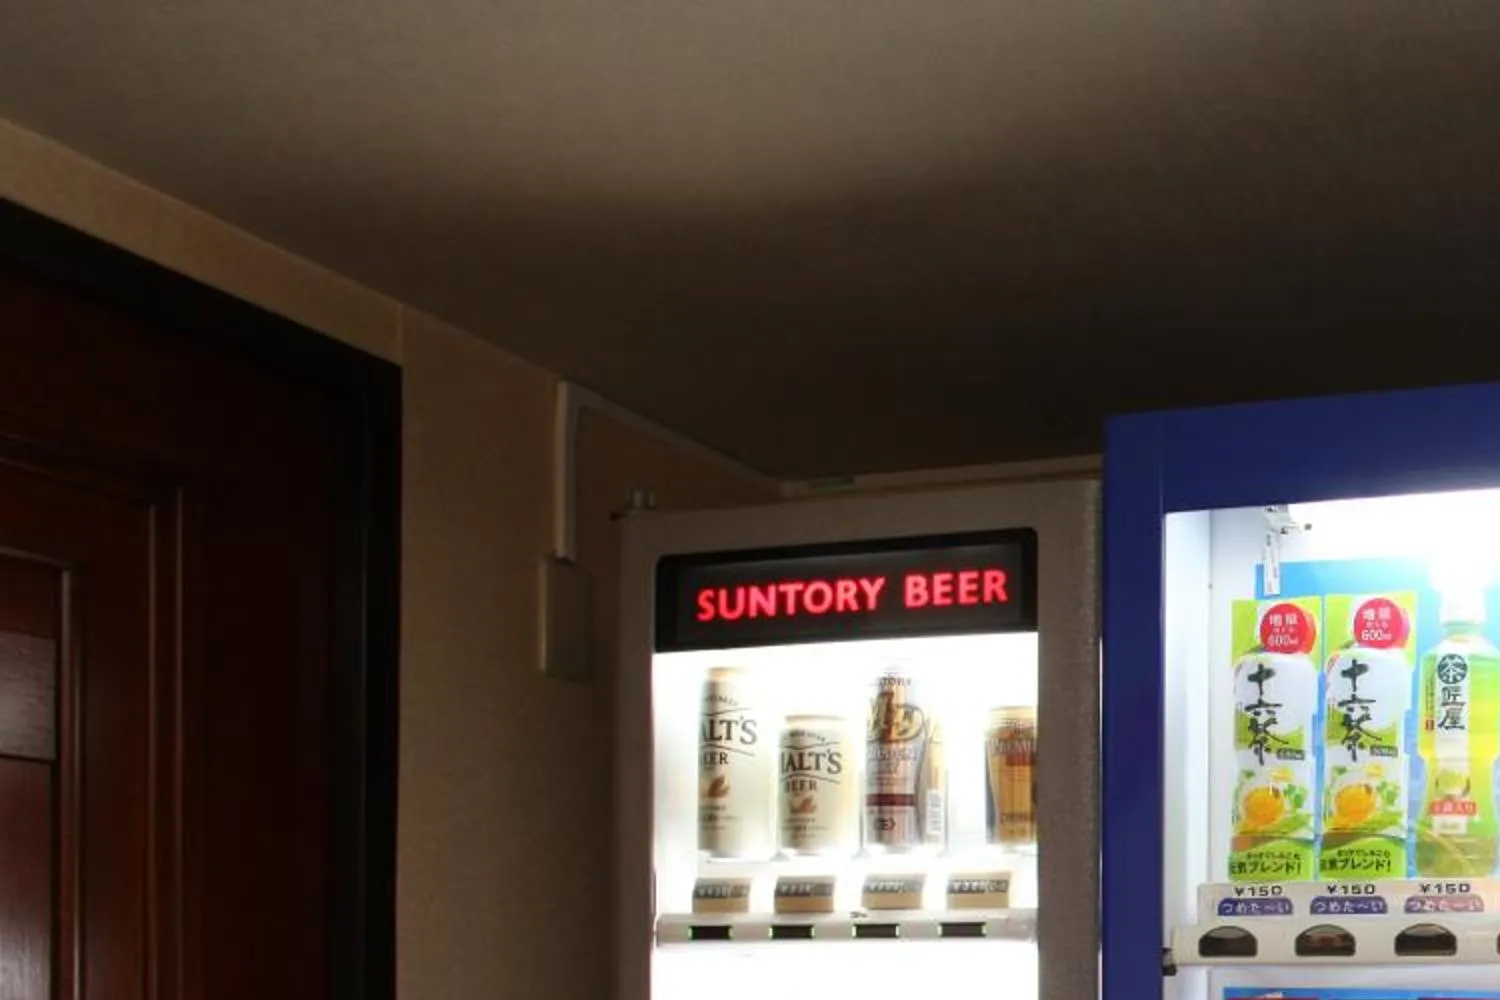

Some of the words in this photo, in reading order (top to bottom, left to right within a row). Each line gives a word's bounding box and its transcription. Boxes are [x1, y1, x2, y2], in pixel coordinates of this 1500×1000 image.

[696, 577, 886, 623] SUNTORY
[904, 568, 1009, 609] BEER
[1234, 884, 1282, 897] ¥150
[1327, 882, 1376, 895] ¥150
[1419, 881, 1470, 894] ¥150
